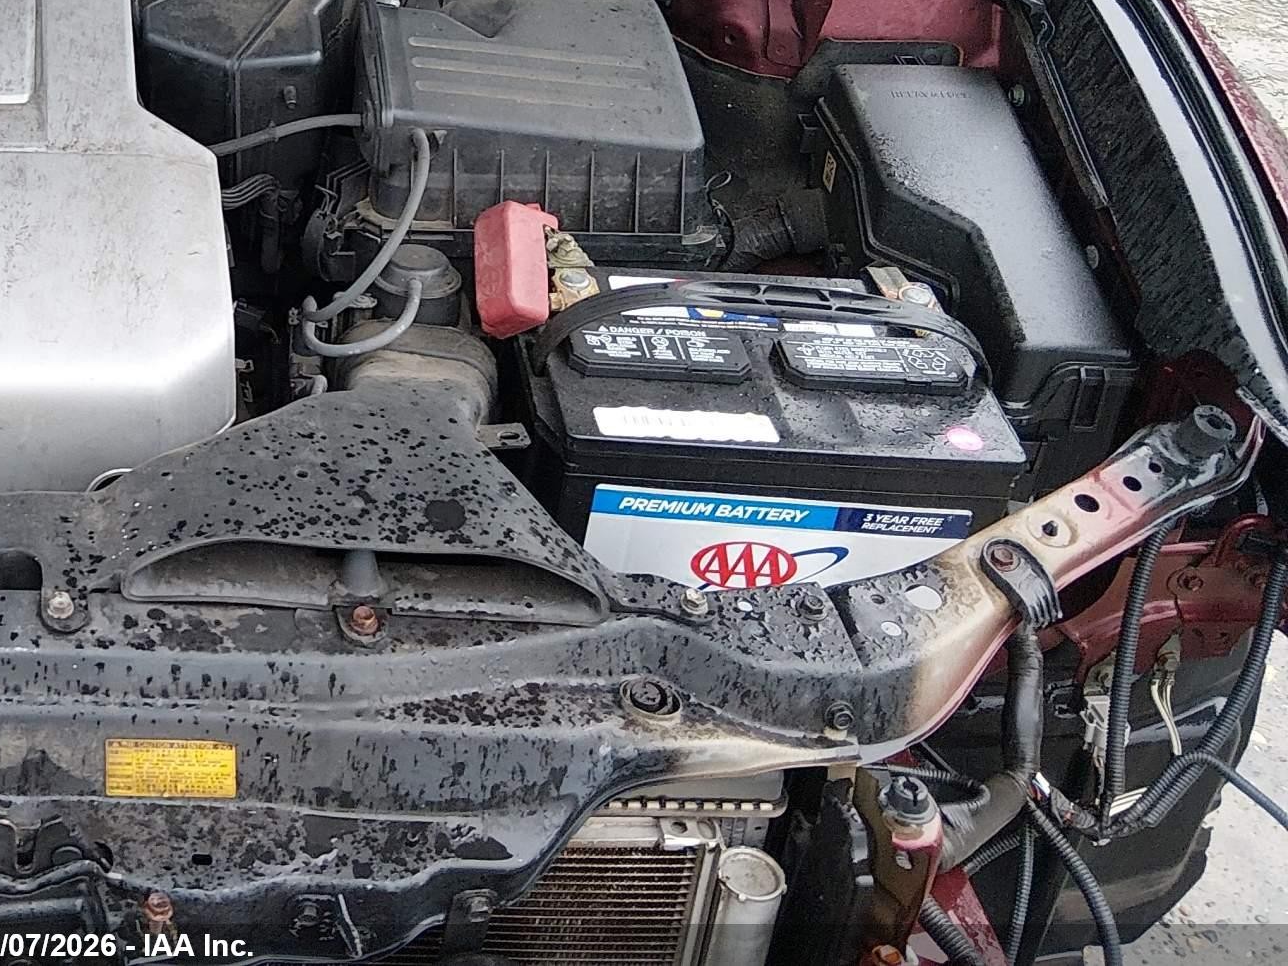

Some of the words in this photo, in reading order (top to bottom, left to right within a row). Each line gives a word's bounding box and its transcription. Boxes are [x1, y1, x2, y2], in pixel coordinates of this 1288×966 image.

[609, 325, 655, 334] DANGER
[664, 328, 707, 337] POISON
[619, 497, 713, 516] PREMIUM
[715, 504, 809, 523] BATTERY
[863, 513, 874, 522] 3
[875, 514, 909, 525] YEAR
[909, 516, 945, 527] FREE
[694, 541, 794, 589] AAA
